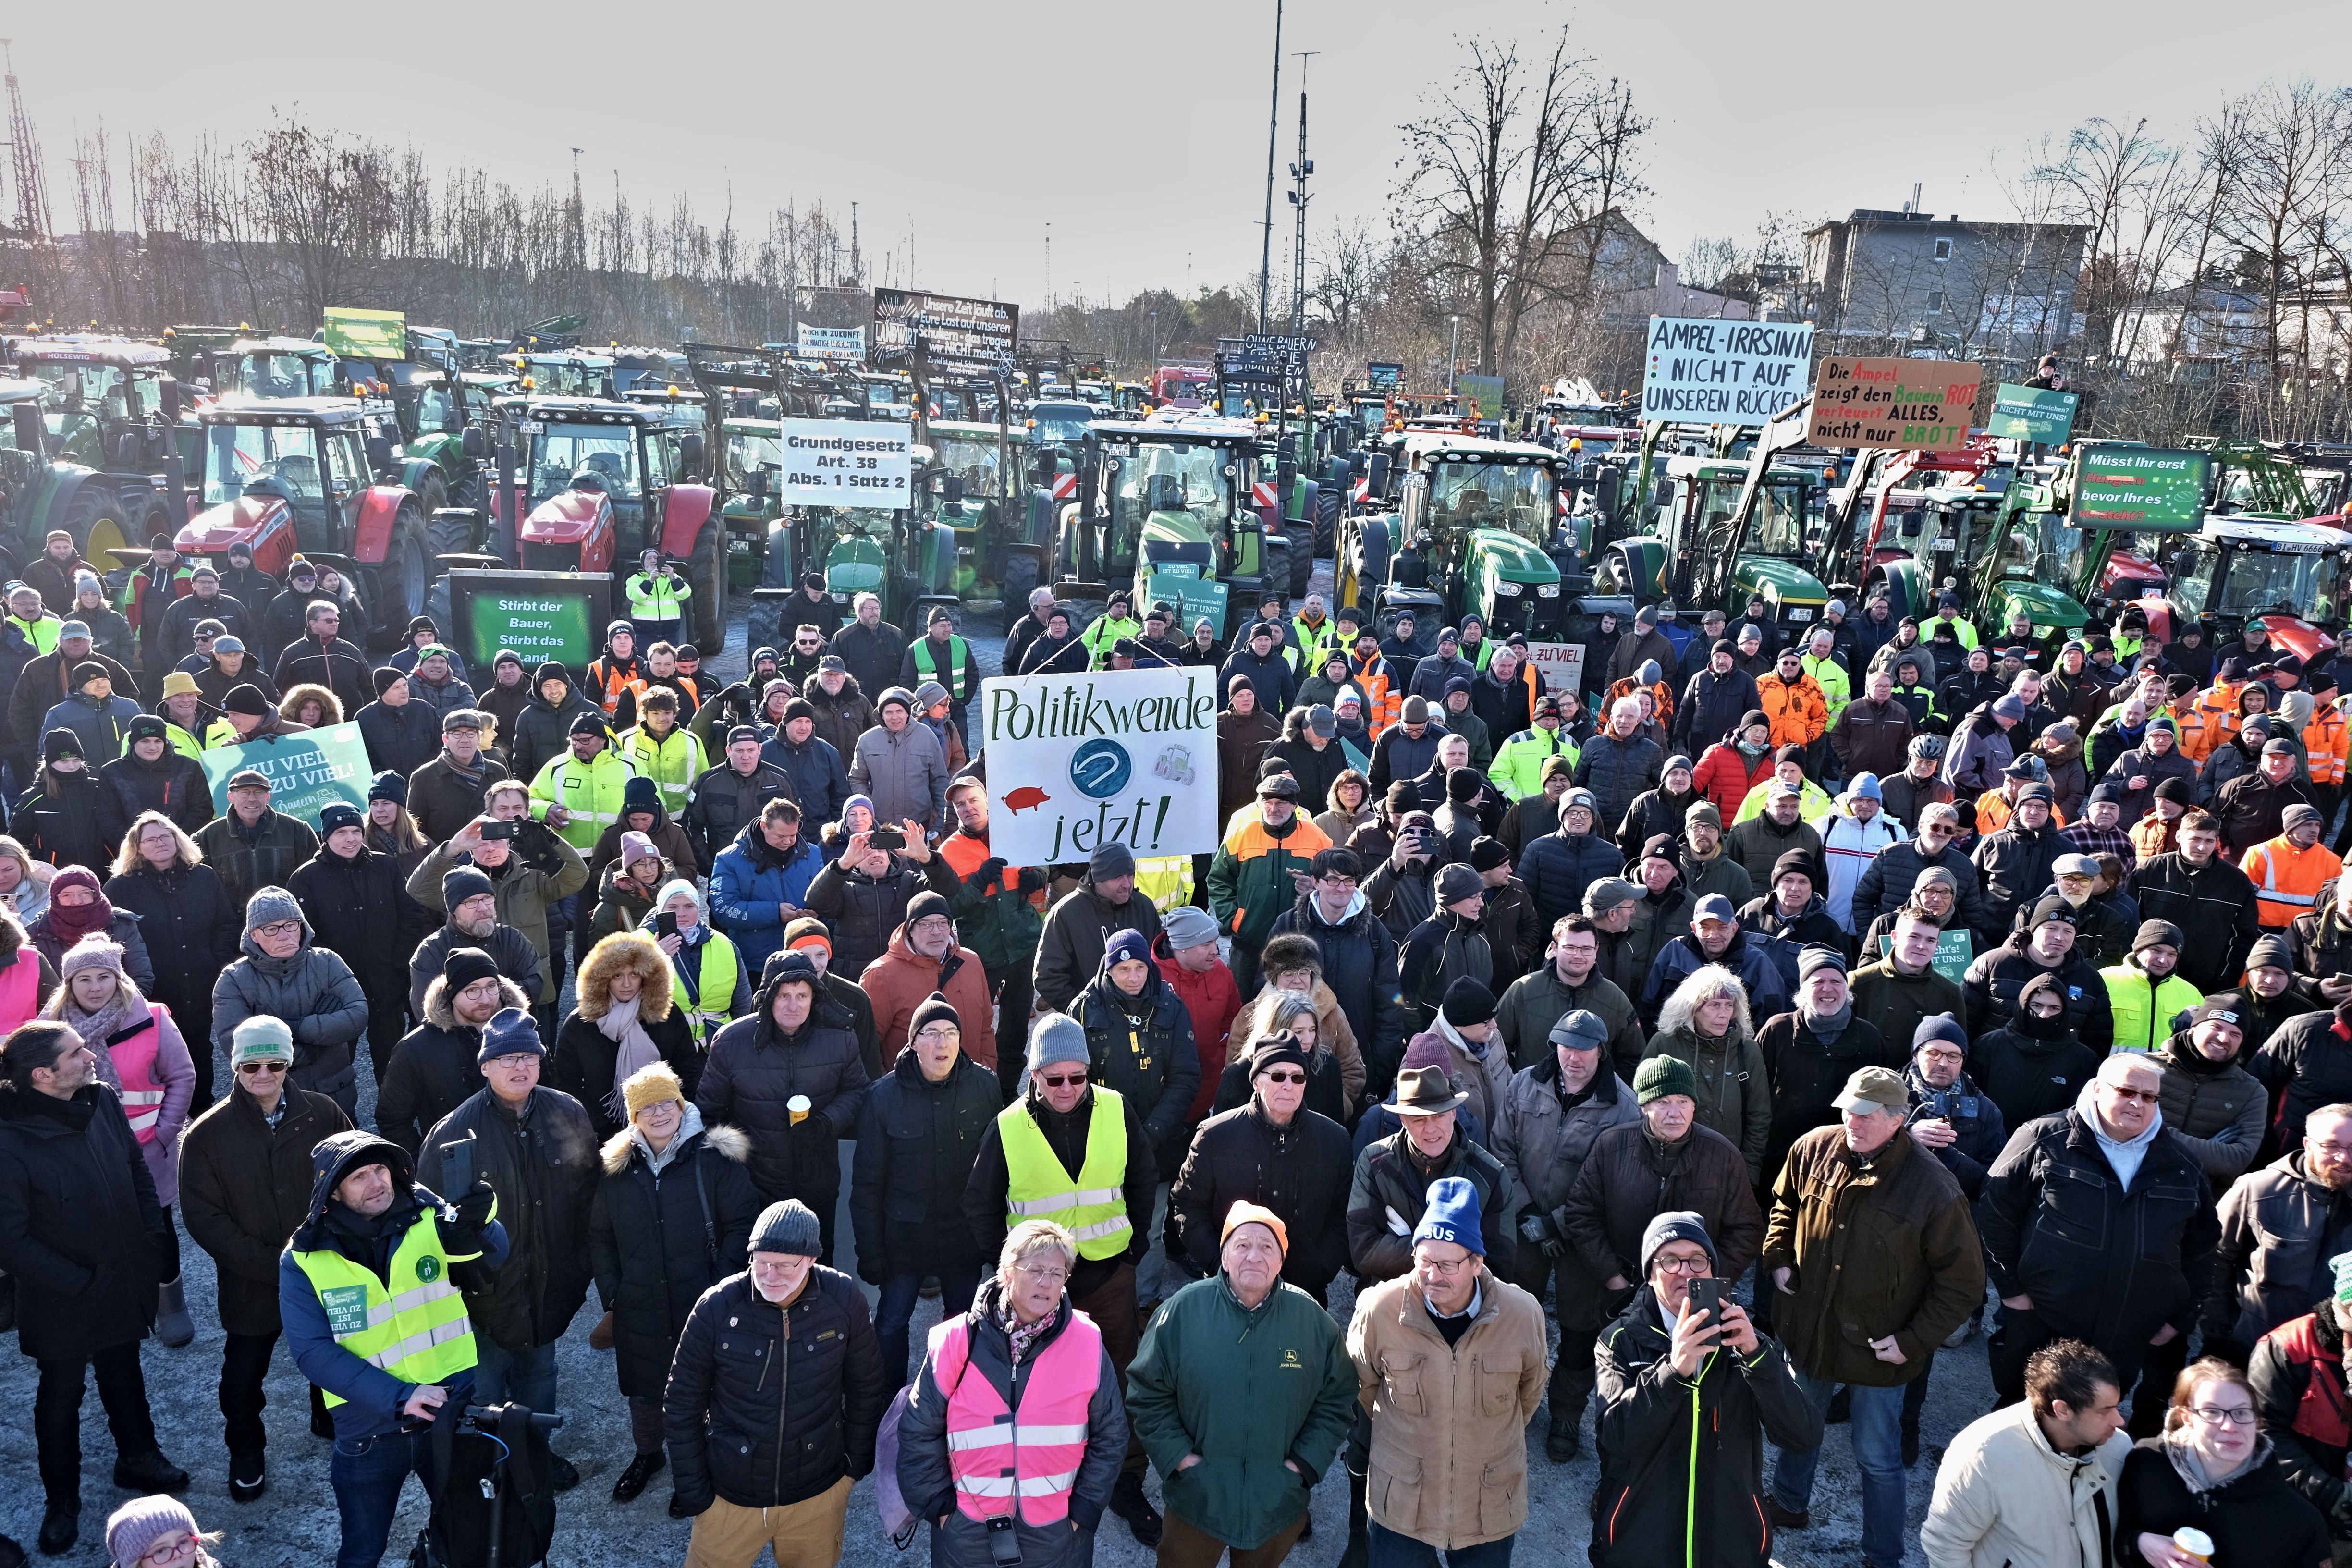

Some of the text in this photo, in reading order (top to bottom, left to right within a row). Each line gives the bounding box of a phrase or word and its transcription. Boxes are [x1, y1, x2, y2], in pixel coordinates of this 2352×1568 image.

[923, 296, 1008, 319] Unsere Zeit läuft ab.
[920, 310, 1010, 334] Eure Last auf unseren
[876, 323, 918, 345] LANDWIRT
[918, 324, 958, 339] Schultern
[965, 330, 981, 344] das
[982, 333, 1011, 348] tragen
[1651, 320, 1813, 359] AMPEL-IRRSINN
[929, 340, 942, 353] wir
[945, 342, 972, 356] NICHT
[1277, 336, 1317, 351] BAUERN
[48, 352, 90, 360] HÜLSEWIG
[1672, 358, 1796, 386] NICHT AUF
[1829, 361, 1898, 383] Die Ampel
[1647, 386, 1729, 412] UNSEREN
[1820, 384, 1979, 411] zeigt den Bauern ROT,
[2000, 398, 2070, 413] Agrardiesel streichen?
[1816, 404, 1944, 423] verteuert ALLES,
[1999, 405, 2067, 421] NICHT MIT UNS!
[1817, 421, 1967, 446] nicht nur BROT!
[788, 436, 905, 452] Grundgesetz
[816, 455, 877, 469] Art. 38
[2089, 454, 2187, 470] Müsst Ihr erst
[788, 472, 905, 488] Abs. 1 Satz 2
[2085, 472, 2146, 487] Hungern
[2081, 490, 2162, 505] bevor Ihr es
[2078, 510, 2145, 521] versteht?
[2303, 545, 2323, 553] 6666
[498, 600, 563, 612] Stirbt der
[1181, 602, 1220, 614] MIT UNS!
[1185, 596, 1222, 605] Landwirtschaft!
[509, 617, 552, 631] Bauer,
[499, 635, 564, 647] Stirbt das
[518, 652, 549, 663] Land
[1536, 649, 1554, 661] ZU
[1552, 647, 1580, 662] VIEL
[991, 676, 1214, 741] Politikwende
[246, 749, 329, 776] ZU VIEL
[269, 762, 355, 794] ZU VIEL!
[276, 795, 317, 816] Bauern
[1044, 795, 1171, 862] jetzt!
[1942, 955, 1965, 964] UNS!
[1423, 1227, 1455, 1242] SUS
[327, 1304, 361, 1316] ZU VIEL!
[337, 1314, 351, 1322] IST
[350, 1320, 361, 1328] ZU
